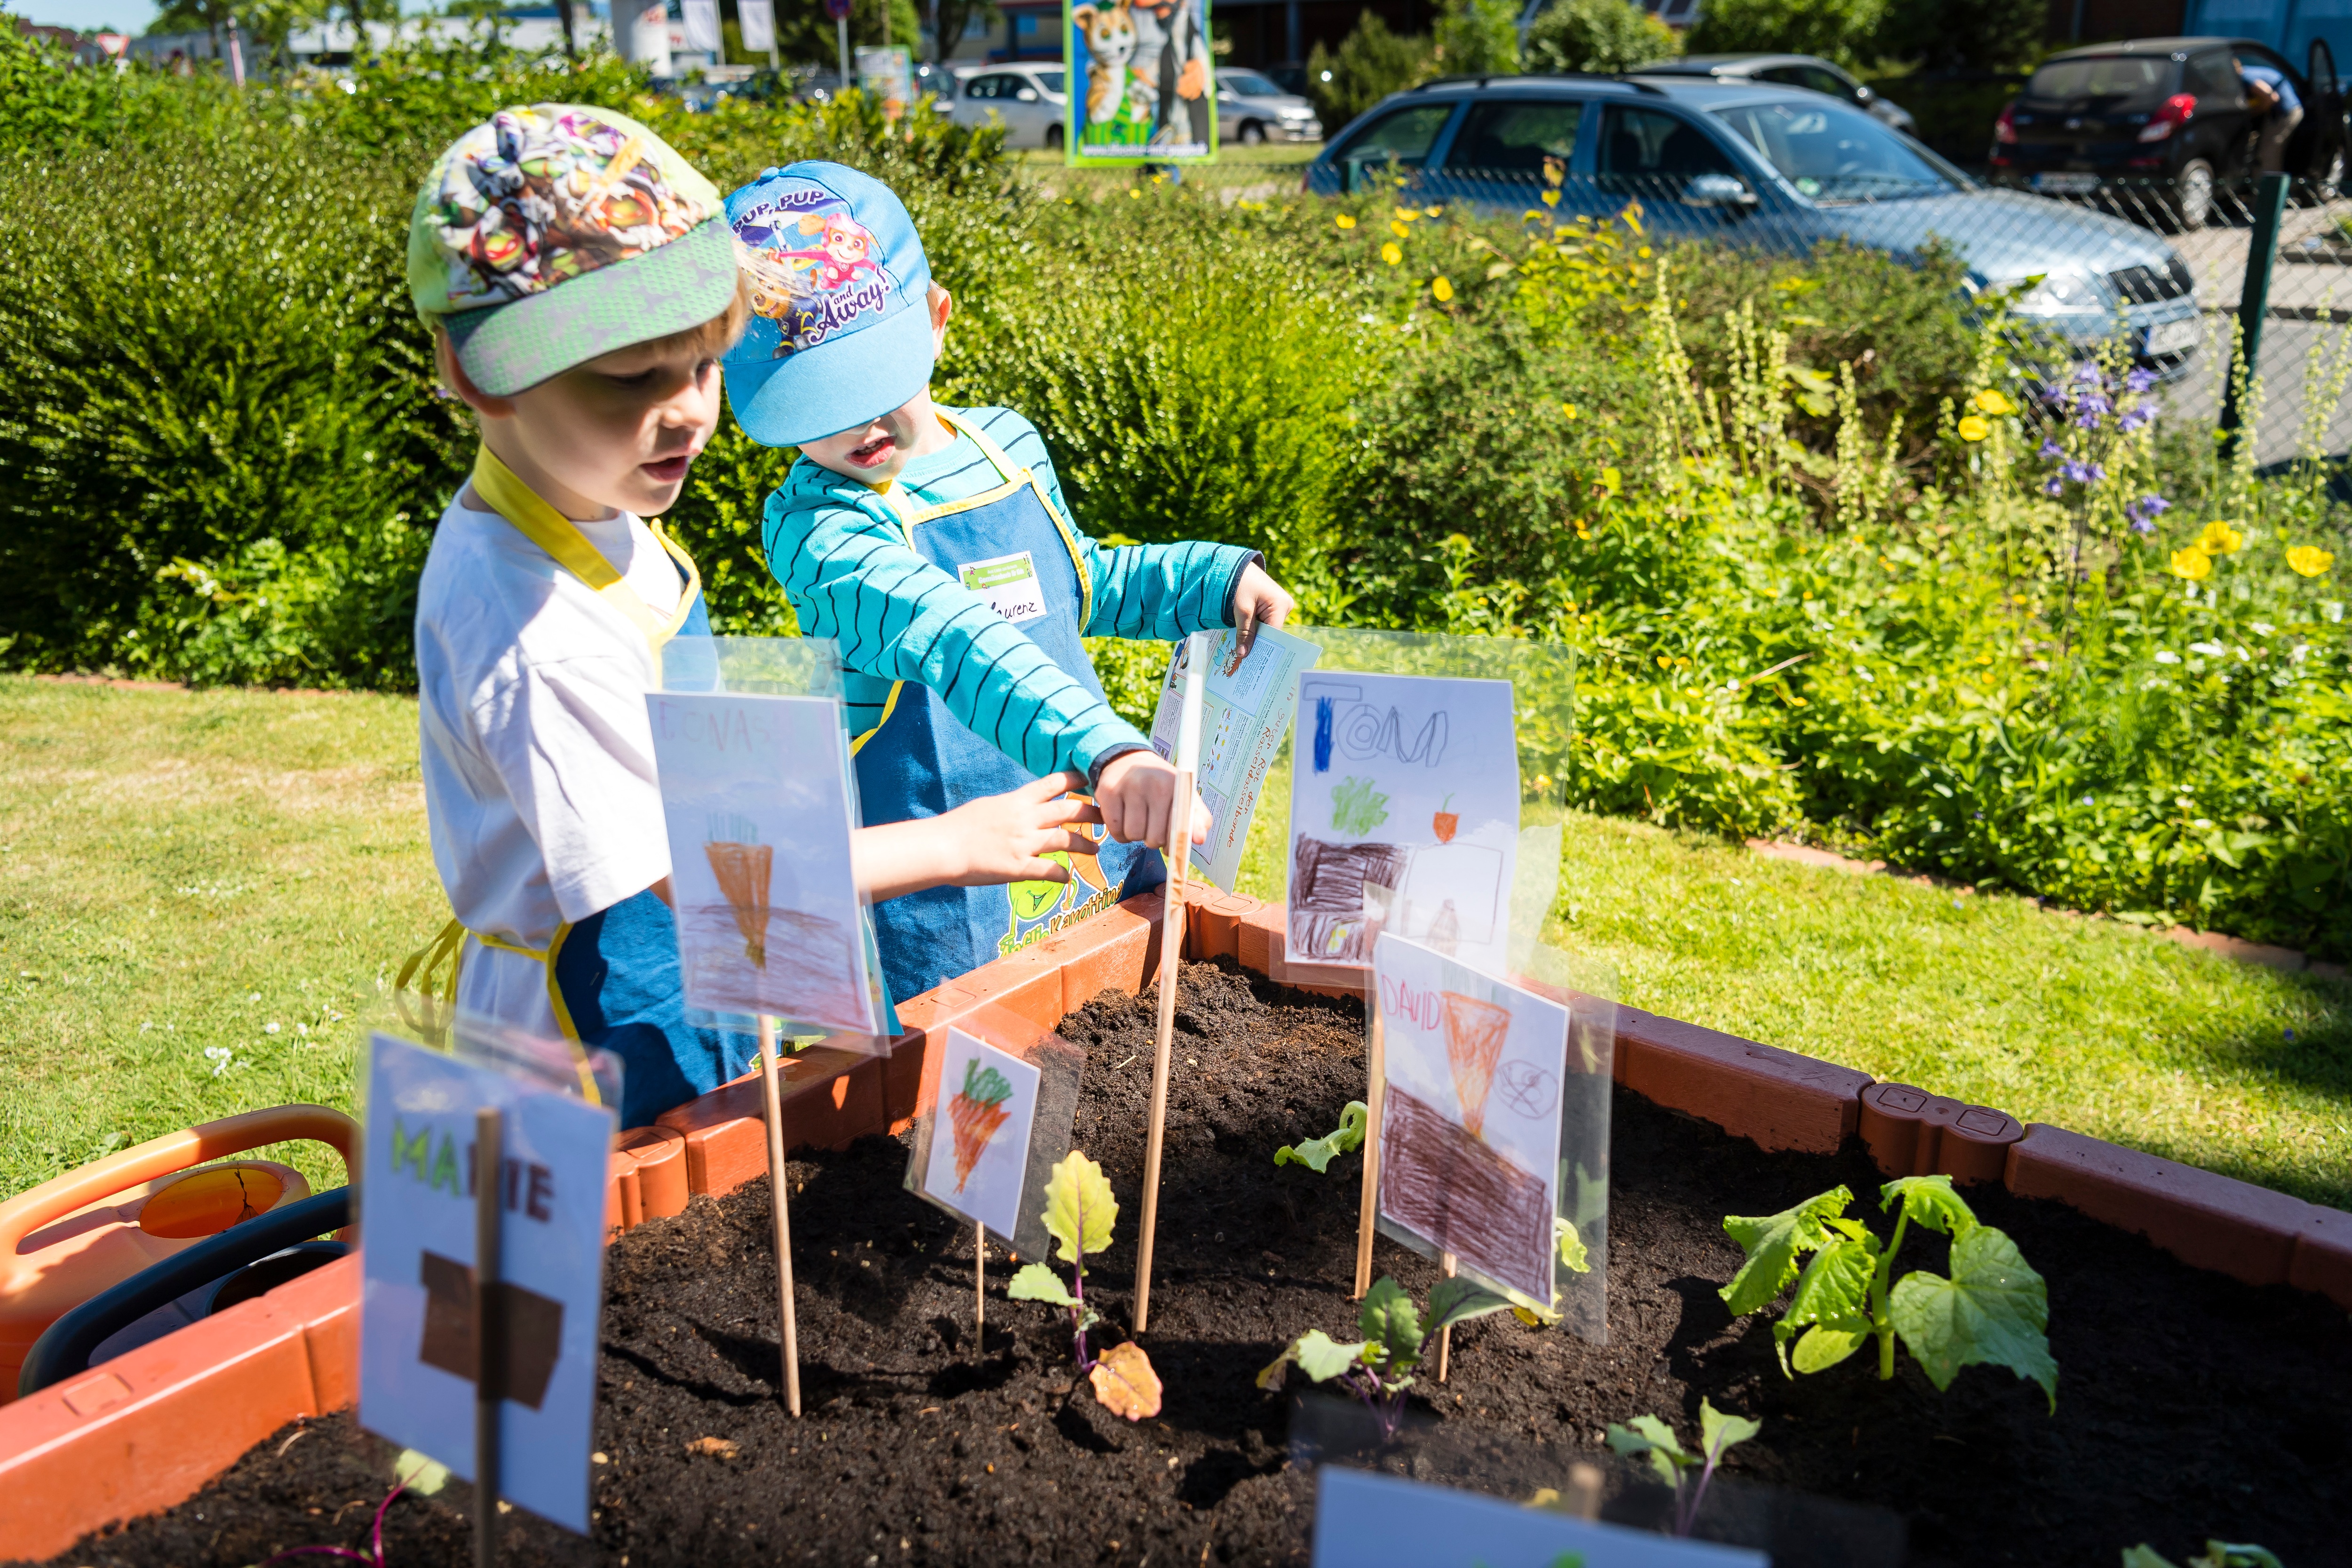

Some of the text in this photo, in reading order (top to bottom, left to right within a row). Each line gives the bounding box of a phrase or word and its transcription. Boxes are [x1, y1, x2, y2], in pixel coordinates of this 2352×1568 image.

[732, 190, 824, 234] PUP, PUP
[810, 264, 890, 343] Away!
[834, 284, 853, 305] and
[1267, 708, 1285, 749] guter
[1226, 727, 1271, 848] Rasseldasselbande
[1253, 757, 1266, 783] Rat
[1244, 791, 1253, 815] der
[1381, 974, 1441, 1031] DAVID
